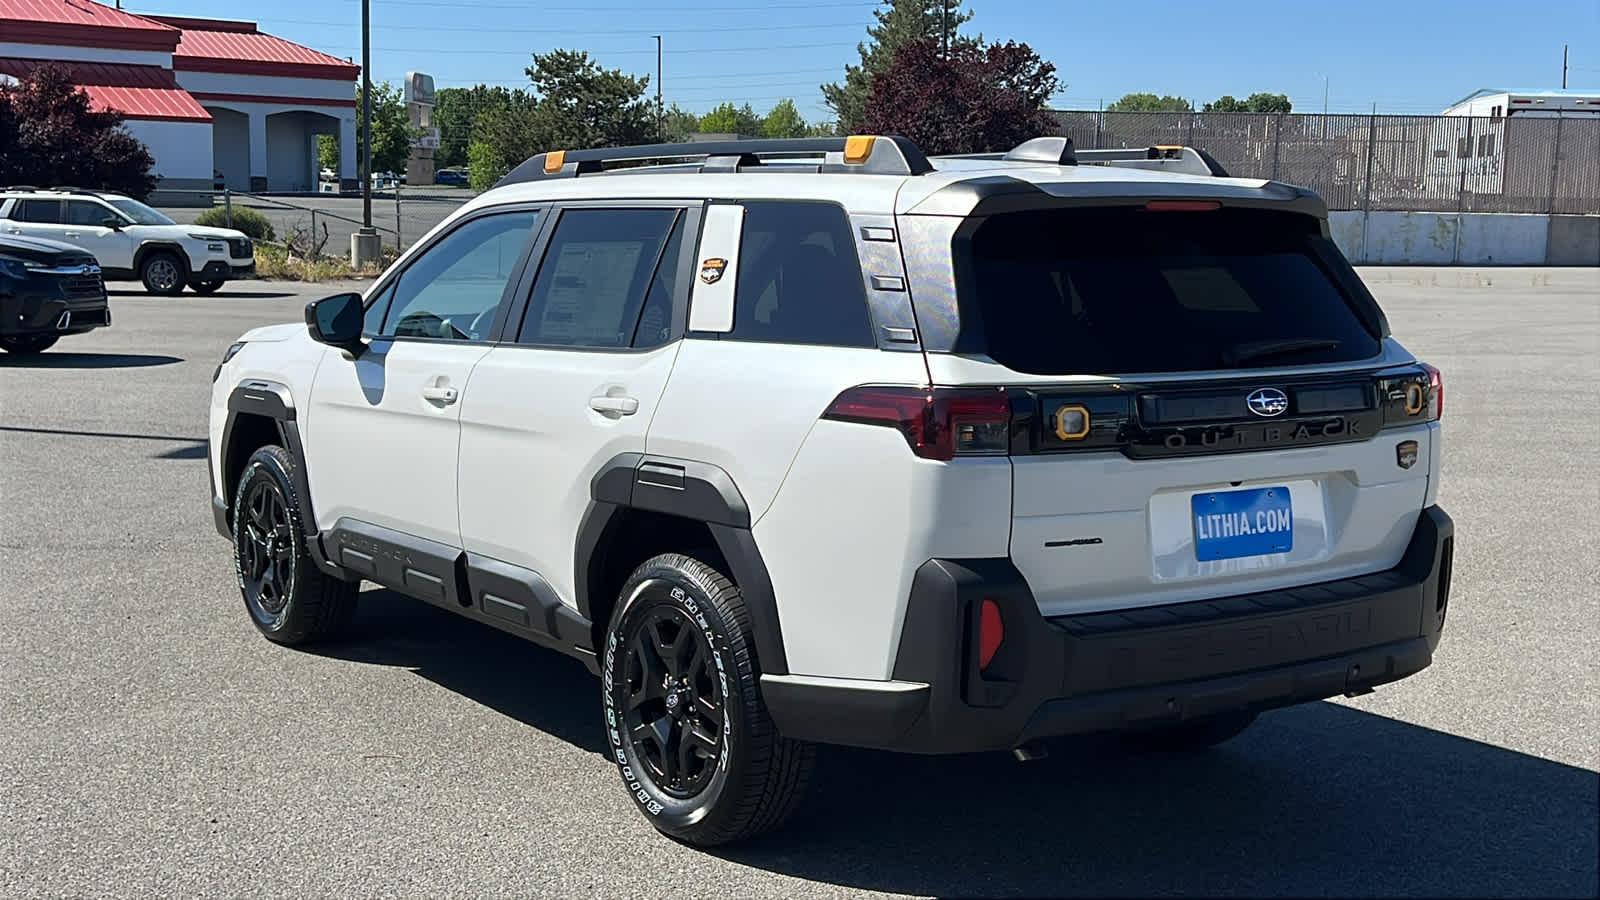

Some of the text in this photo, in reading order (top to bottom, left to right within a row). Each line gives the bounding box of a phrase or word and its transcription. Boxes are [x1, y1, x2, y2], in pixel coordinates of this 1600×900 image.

[1163, 417, 1361, 450] OUTBACK
[1197, 507, 1291, 541] LITHIA.COM
[604, 631, 664, 816] BRIDGESTONE
